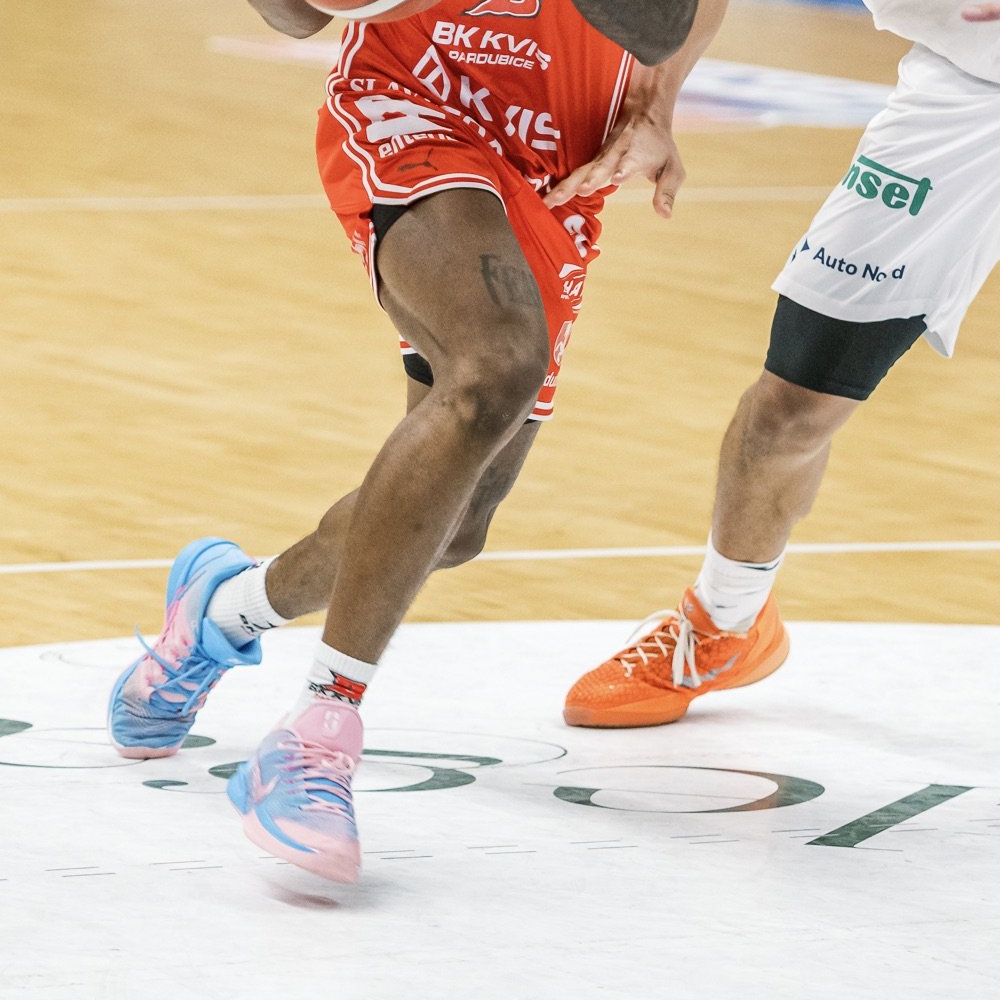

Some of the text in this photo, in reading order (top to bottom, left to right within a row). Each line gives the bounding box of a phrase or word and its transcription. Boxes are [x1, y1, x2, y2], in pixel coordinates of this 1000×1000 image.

[432, 20, 480, 49] BK
[812, 246, 906, 283] Auto Nod
